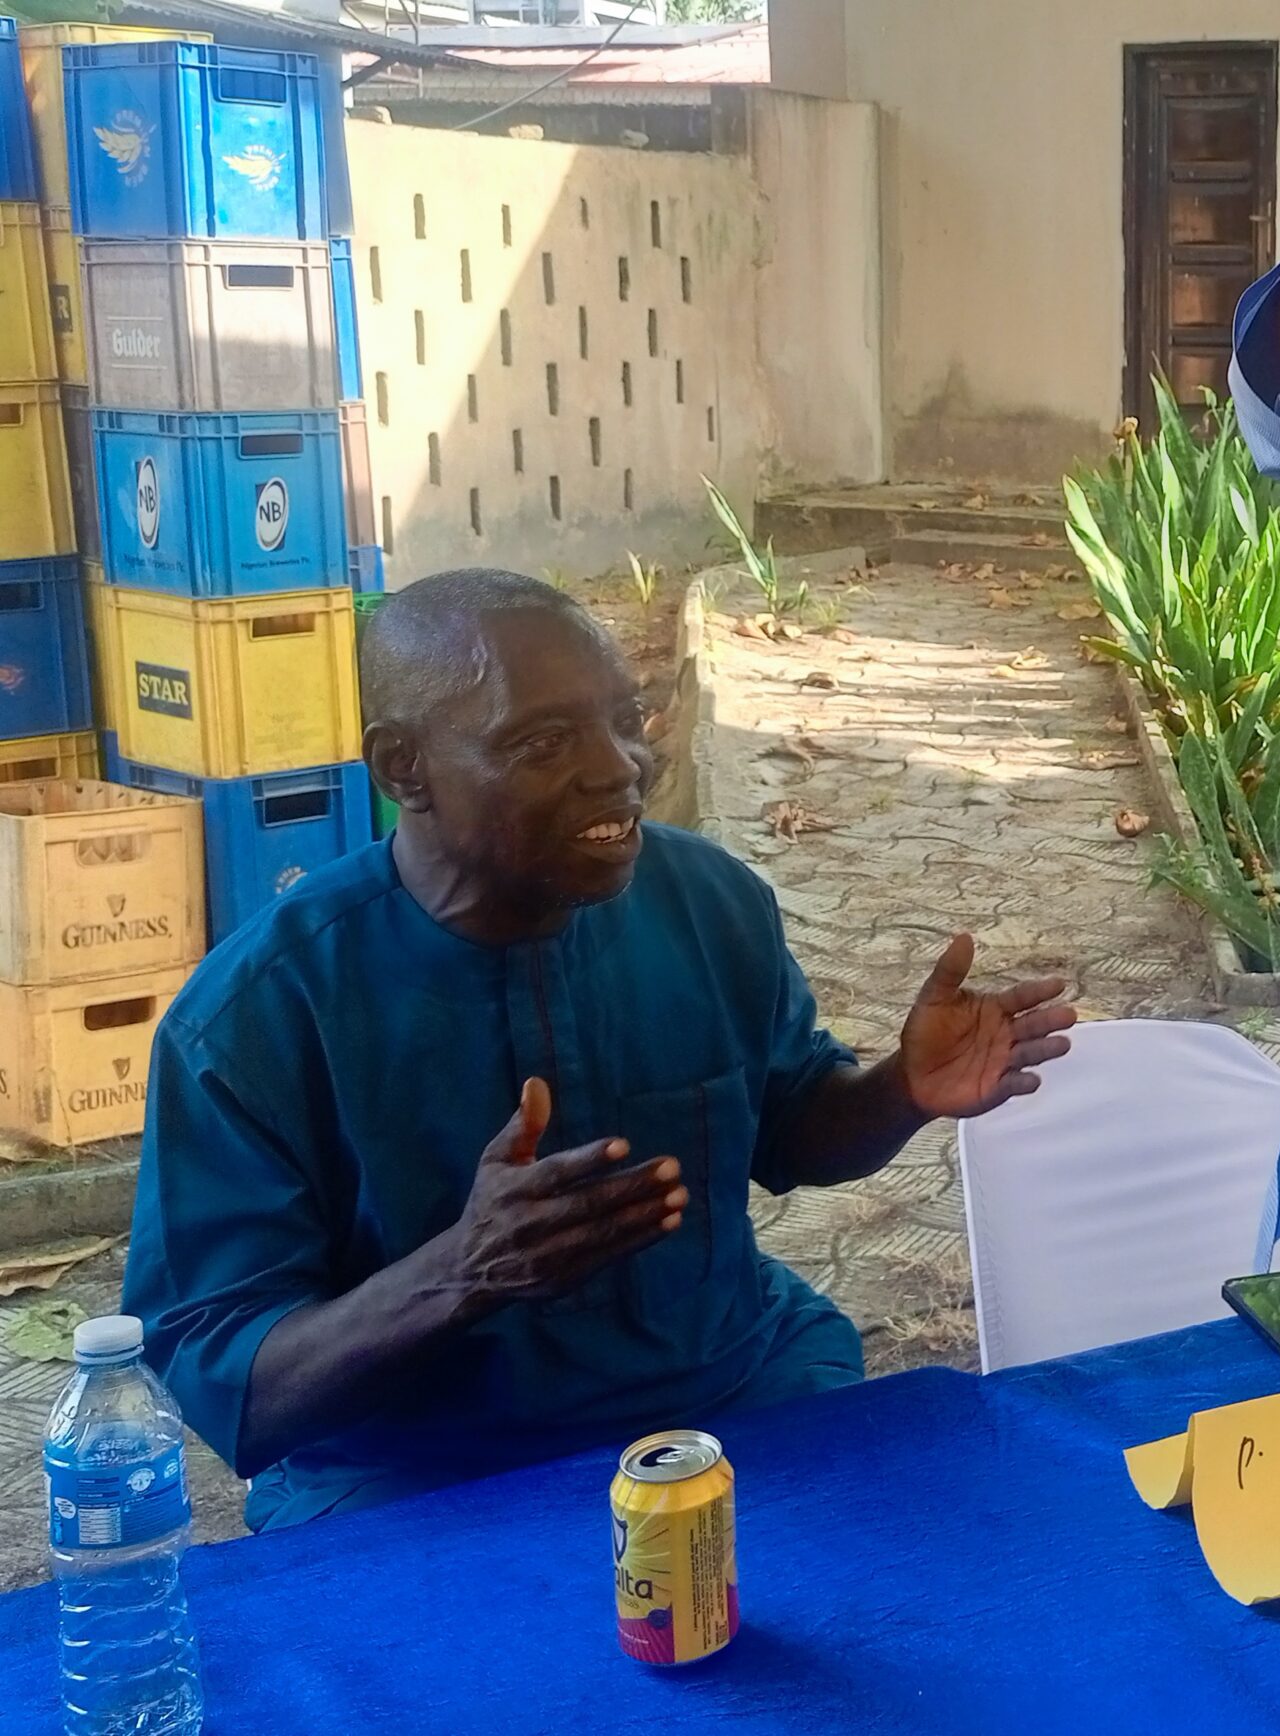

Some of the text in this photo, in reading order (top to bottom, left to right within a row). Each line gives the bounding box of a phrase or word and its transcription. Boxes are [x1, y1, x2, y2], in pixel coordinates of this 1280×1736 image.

[112, 327, 160, 358] Gulder
[139, 486, 156, 514] NB
[259, 501, 282, 523] NB
[138, 672, 189, 707] STAR
